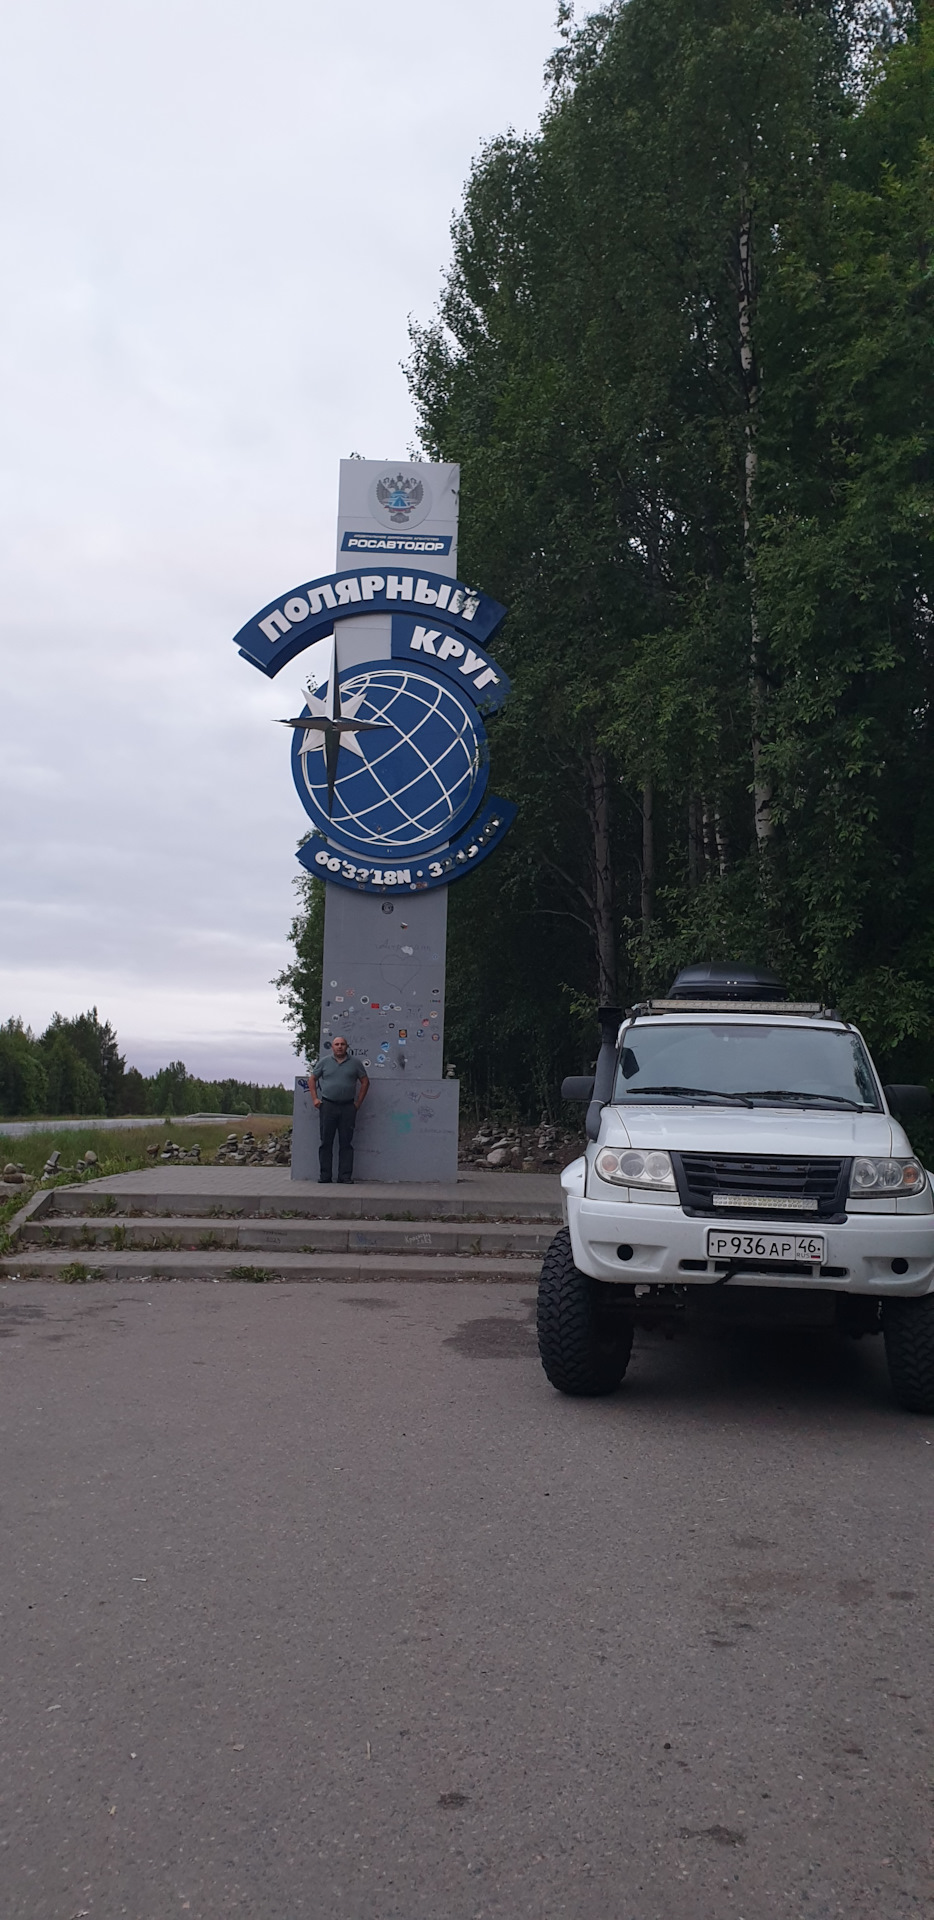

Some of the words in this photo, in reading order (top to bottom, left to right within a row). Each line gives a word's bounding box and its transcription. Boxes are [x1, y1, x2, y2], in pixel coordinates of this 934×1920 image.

[347, 538, 445, 552] РОСАВТОДОР
[257, 575, 482, 643] ПОЛЯРНЫЙ
[410, 625, 500, 690] КРУГ
[798, 1239, 816, 1253] 46
